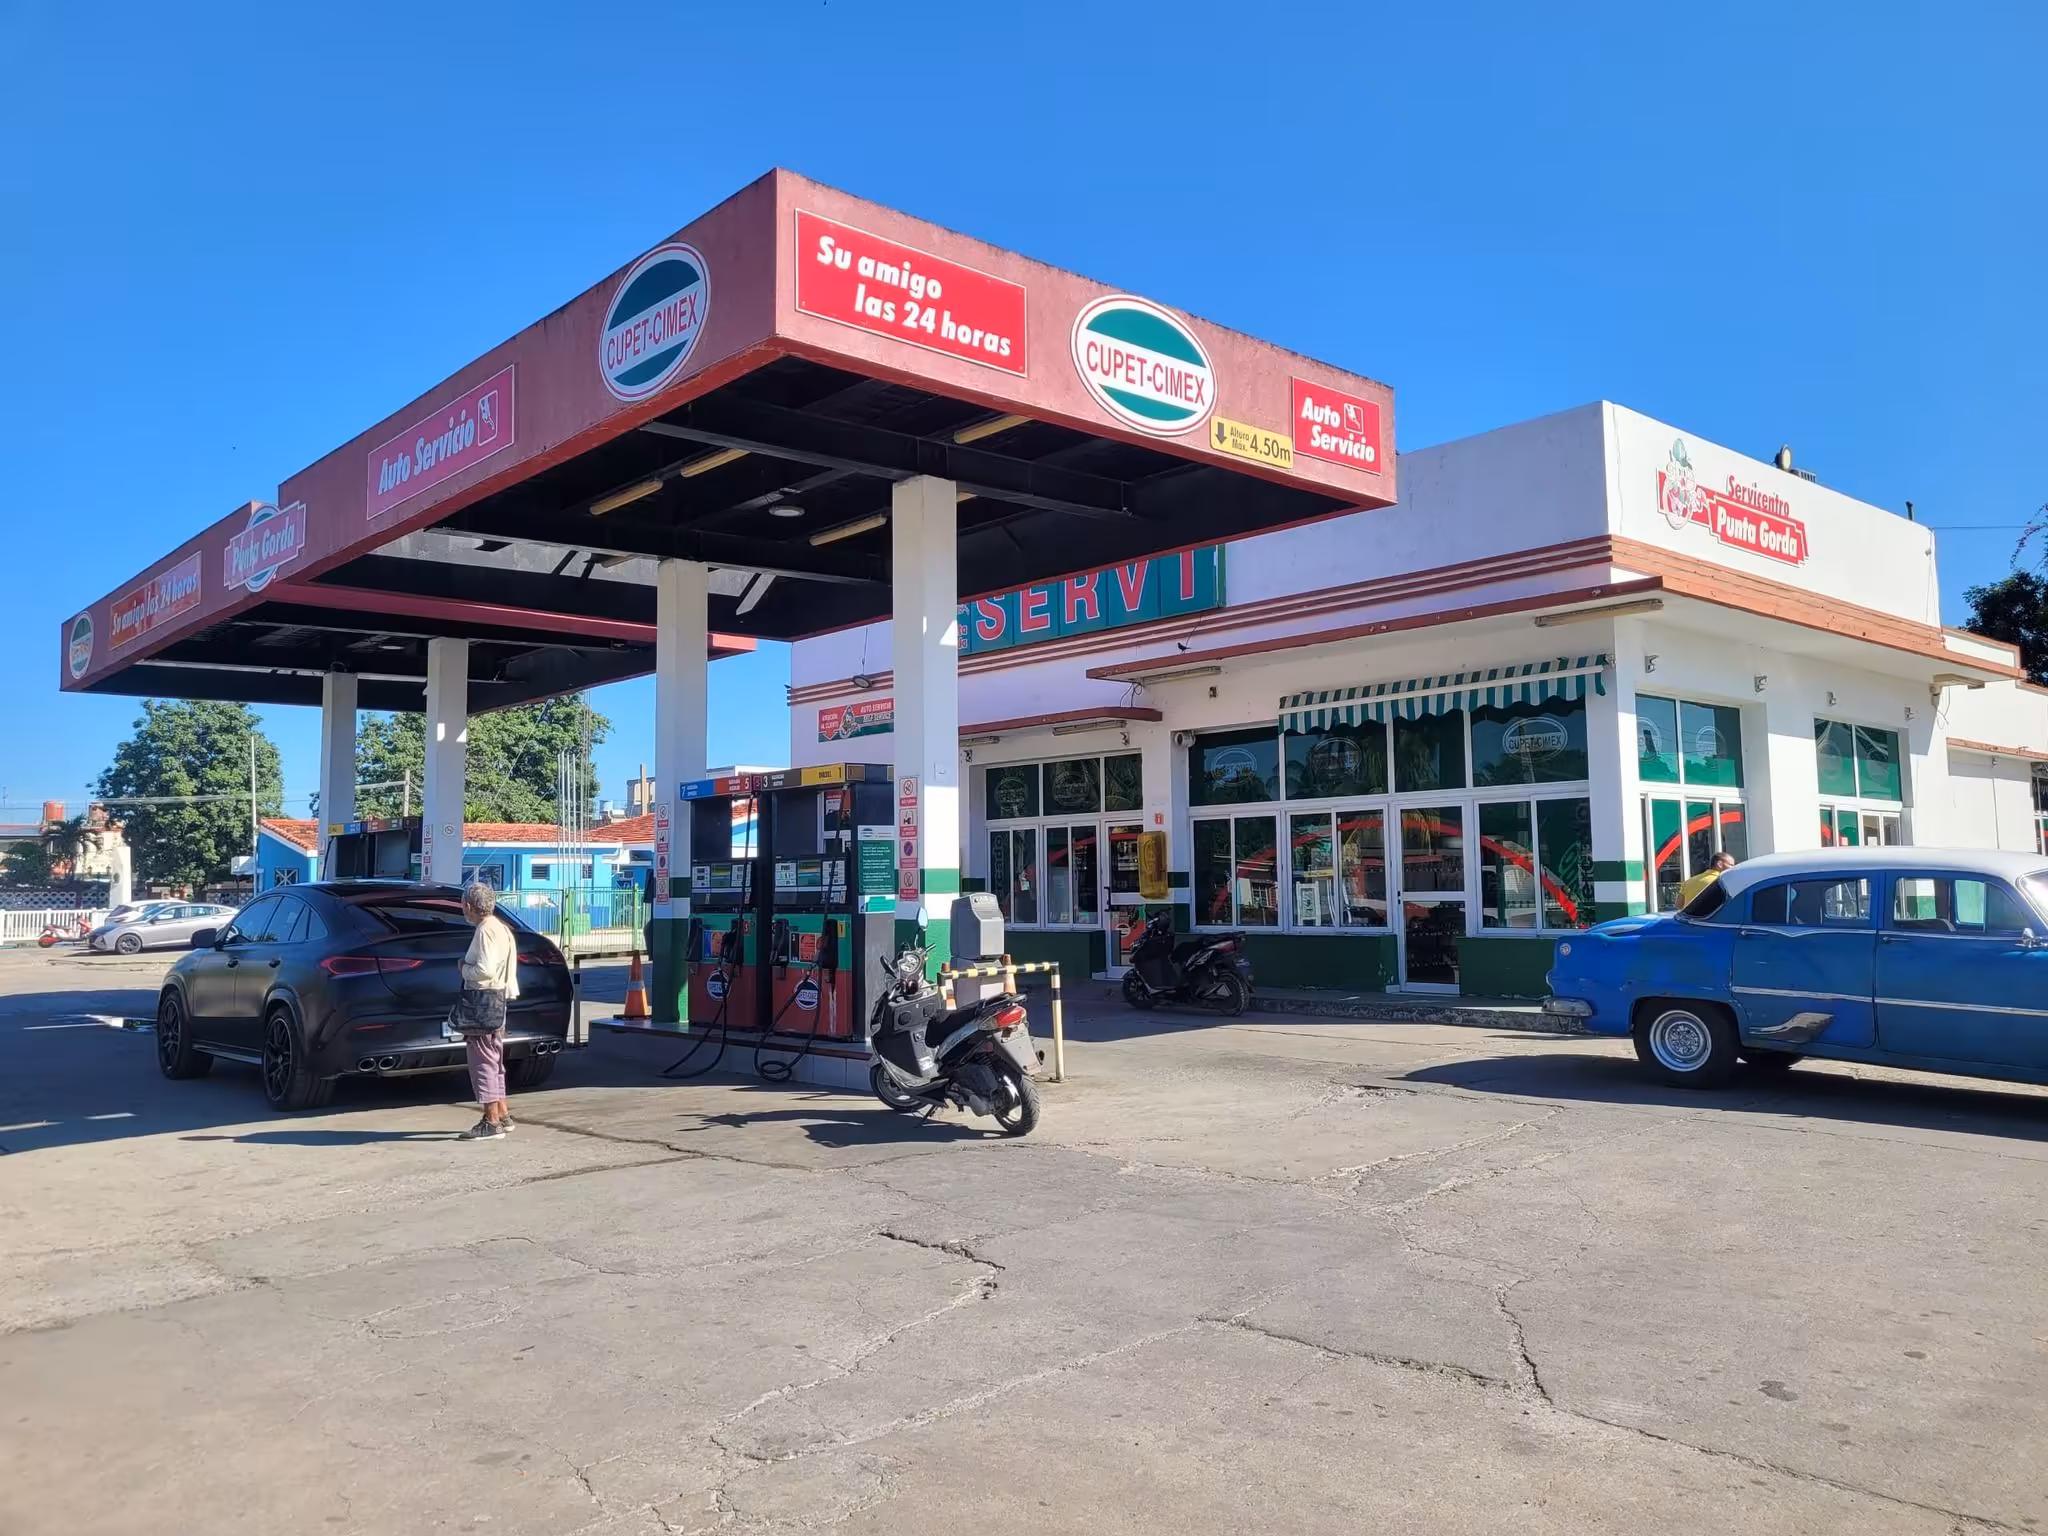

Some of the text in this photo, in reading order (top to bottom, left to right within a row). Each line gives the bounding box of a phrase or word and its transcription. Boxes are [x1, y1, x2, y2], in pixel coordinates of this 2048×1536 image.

[817, 235, 942, 300] Su amigo
[607, 290, 698, 371] CUPET-CIMEX
[854, 283, 1011, 356] las 24 horas
[1086, 340, 1206, 408] CUPET-CIMEX
[1230, 426, 1250, 441] Altura
[1301, 397, 1341, 429] Auto
[377, 409, 475, 495] Auto Servicio
[1250, 434, 1291, 463] 4.50m
[1310, 426, 1376, 463] Servicio
[1728, 475, 1790, 517] Servicentro
[231, 516, 295, 577] Punta Gorda
[1716, 506, 1798, 557] Punta Gorda
[975, 549, 1195, 641] SERVI
[763, 775, 768, 788] 3
